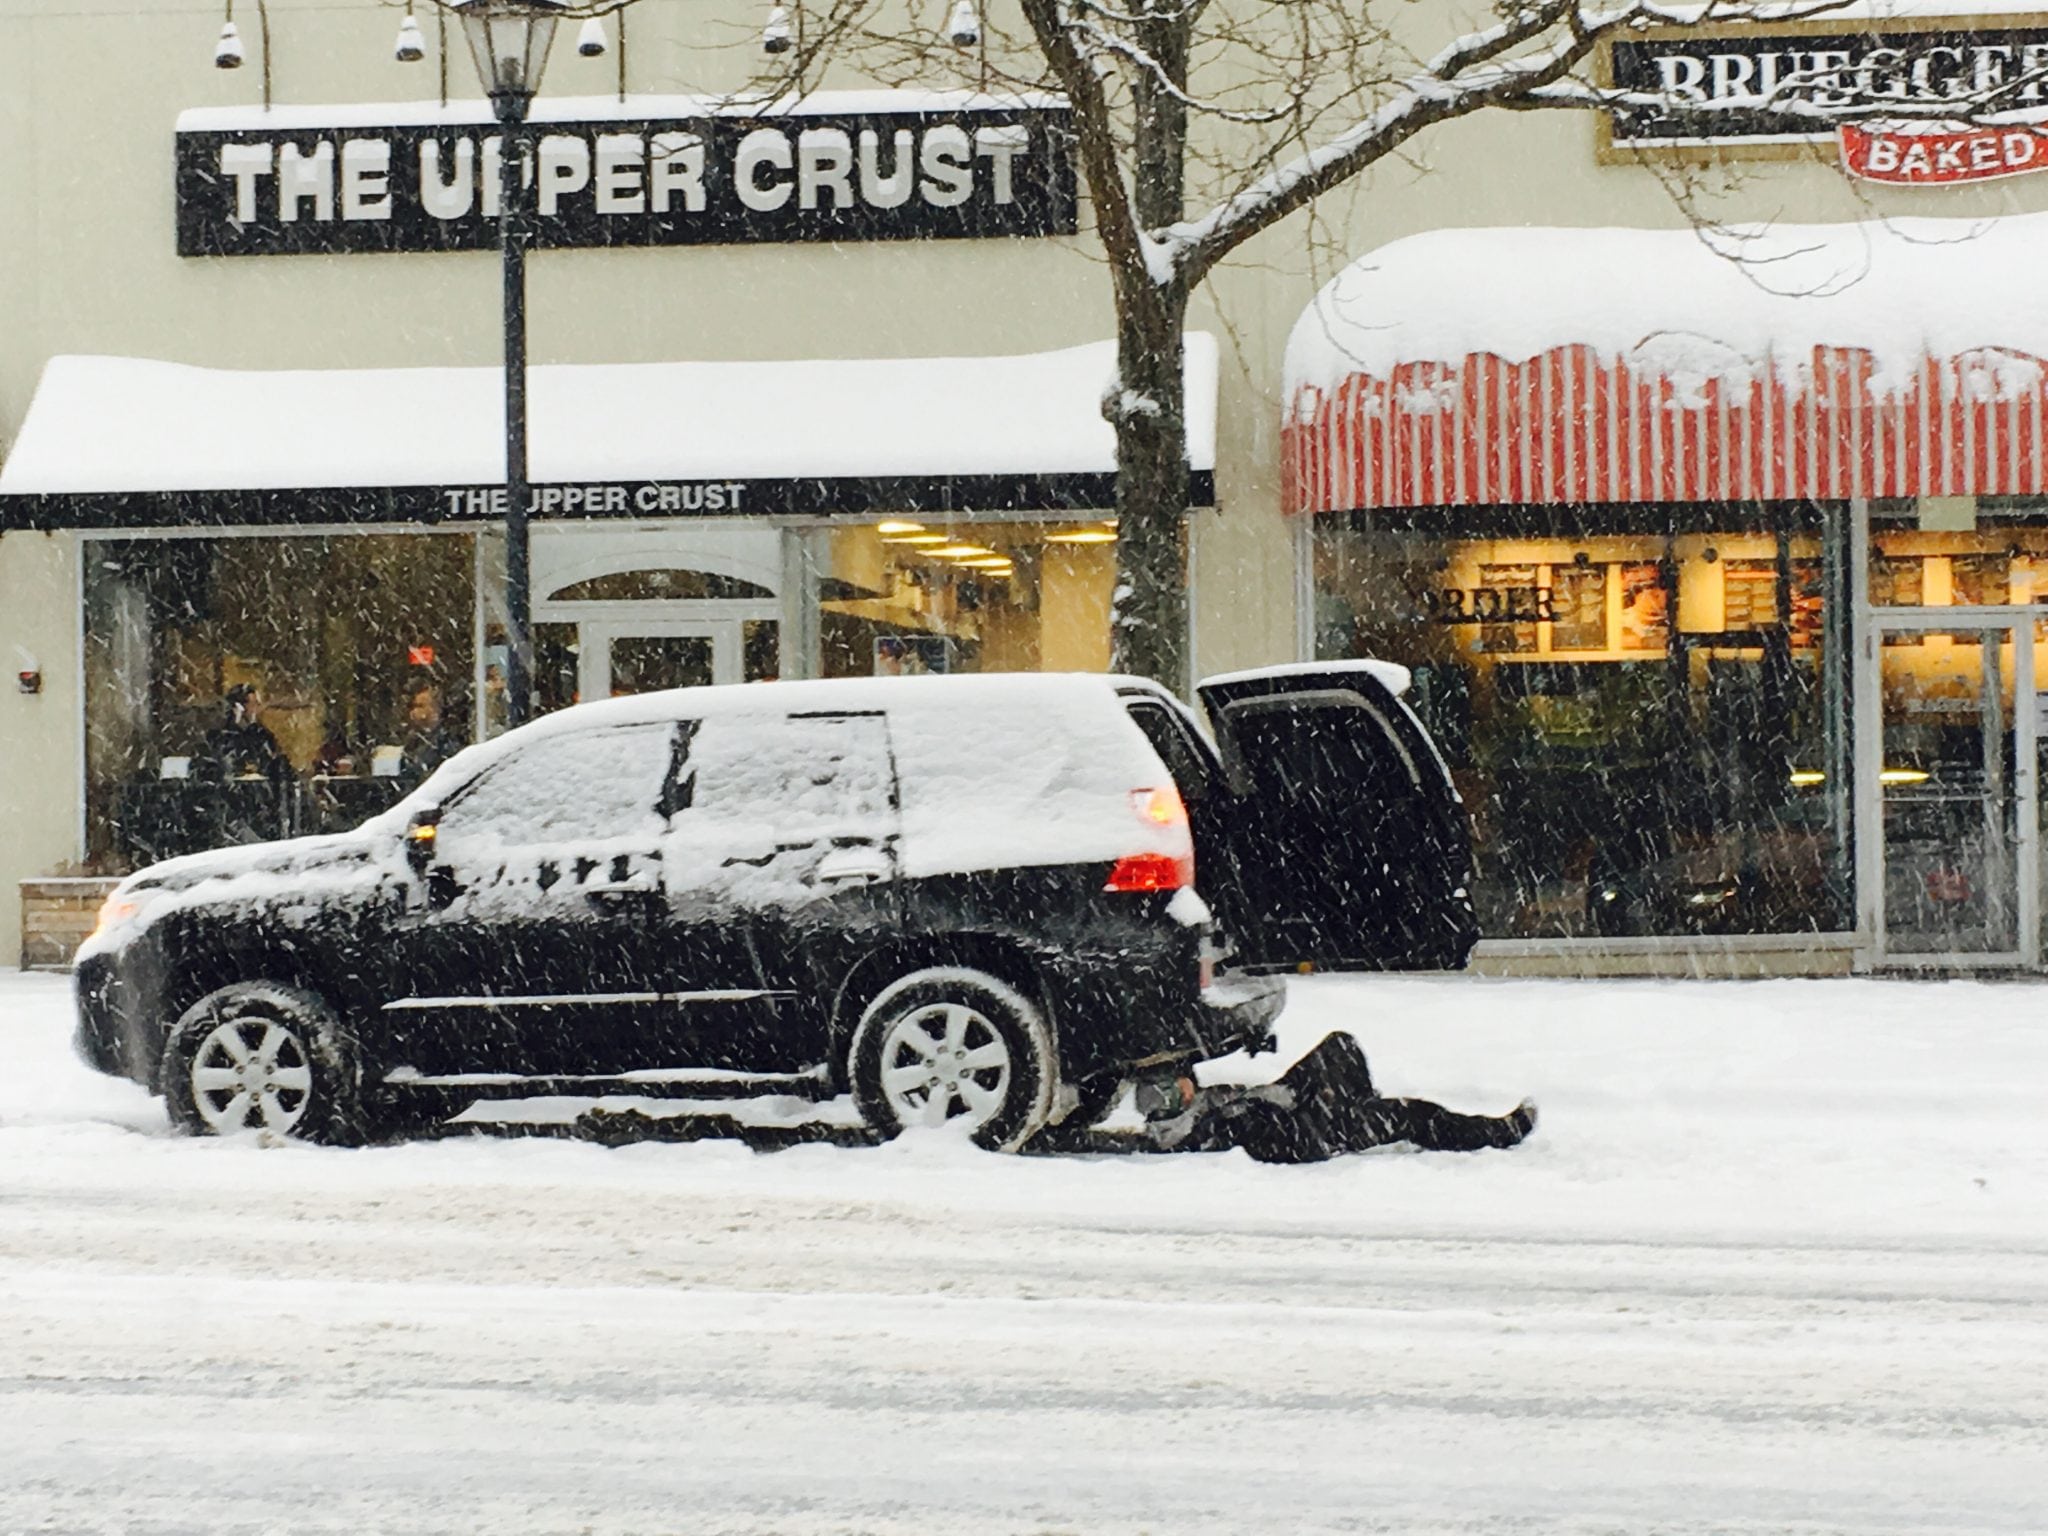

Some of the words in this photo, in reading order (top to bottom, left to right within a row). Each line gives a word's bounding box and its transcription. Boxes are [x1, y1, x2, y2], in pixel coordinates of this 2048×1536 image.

[221, 140, 391, 222] THE
[420, 133, 706, 219] UPPER
[734, 124, 1030, 211] CRUST
[1867, 133, 2036, 175] BAKED
[445, 488, 508, 514] THE
[635, 484, 747, 511] CRUST
